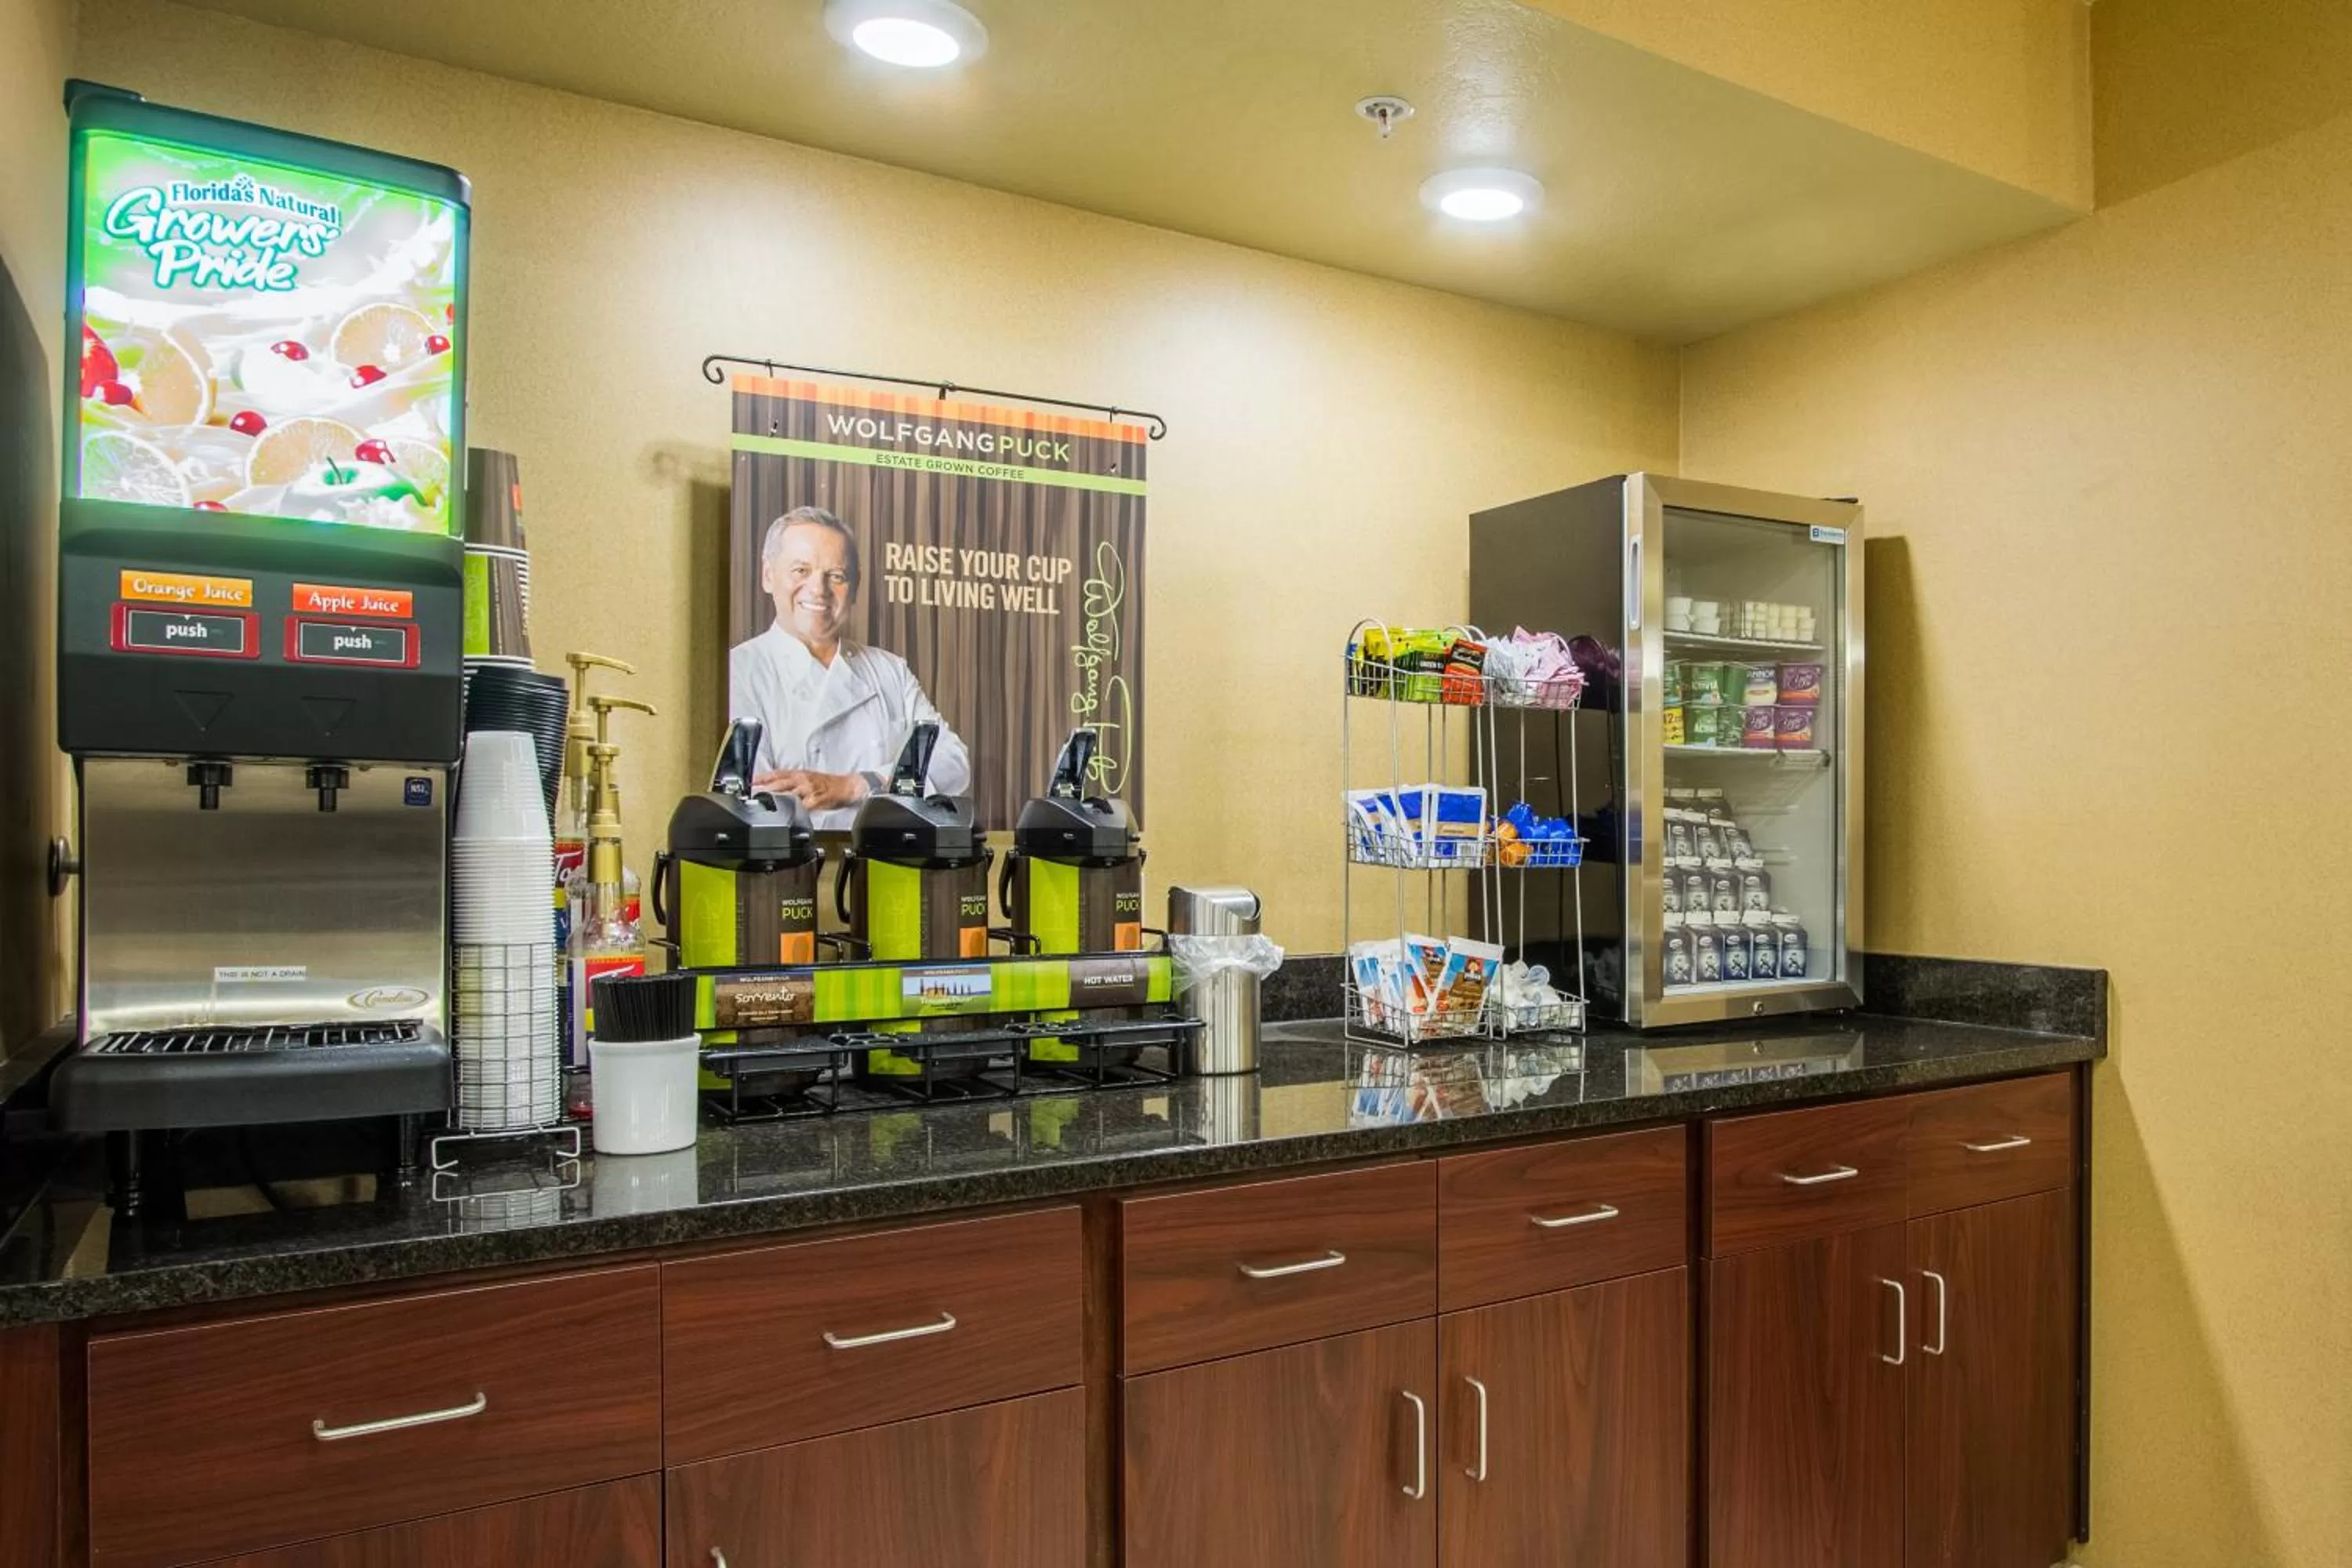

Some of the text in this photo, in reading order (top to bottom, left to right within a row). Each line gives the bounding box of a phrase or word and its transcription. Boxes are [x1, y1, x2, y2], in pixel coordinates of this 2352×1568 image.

[259, 187, 338, 223] Natural
[147, 238, 298, 290] Pride
[826, 412, 1071, 463] WOLFGANG PUCK
[876, 454, 1025, 479] ESTATE GROWN COFFEE
[884, 542, 1073, 584] RAISE YOUR CUP
[132, 578, 245, 601] Orange Juice
[884, 575, 1061, 615] TO LIVING WELL
[308, 591, 400, 613] Apple Juice
[165, 622, 208, 638] push
[333, 634, 372, 650] push
[1084, 975, 1134, 985] HOT WATER
[735, 985, 797, 1004] Sorrento
